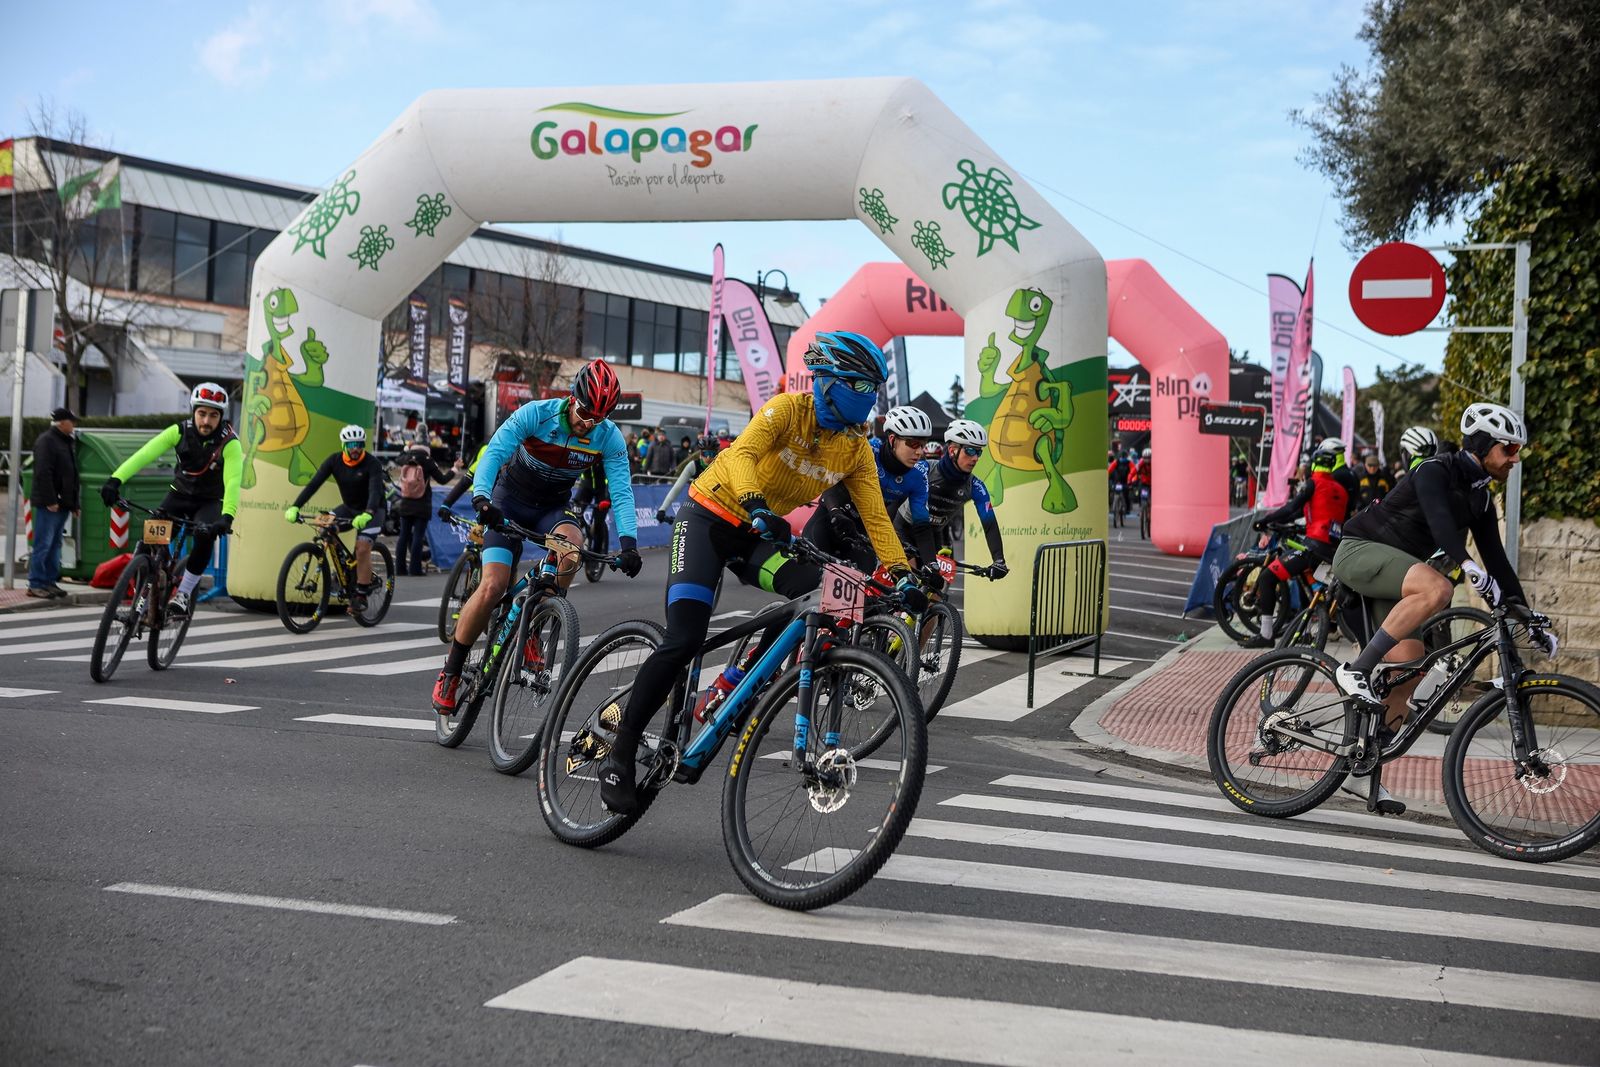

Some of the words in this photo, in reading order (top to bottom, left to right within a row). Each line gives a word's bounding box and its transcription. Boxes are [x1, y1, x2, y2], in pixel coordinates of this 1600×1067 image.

[531, 121, 759, 168] Galapagar
[606, 164, 642, 187] Pasión
[646, 174, 664, 194] por
[668, 163, 679, 188] el
[680, 165, 726, 193] deporte
[906, 278, 953, 312] kl
[1156, 376, 1190, 397] klin
[1213, 416, 1258, 426] SCOTT
[149, 525, 166, 536] 419
[674, 521, 682, 533] DE
[1041, 523, 1051, 536] de
[671, 535, 680, 574] ENMEDIO
[677, 536, 686, 573] MORALEJA
[833, 578, 859, 604] 801
[1517, 679, 1559, 688] AXXIS
[729, 717, 759, 778] MAXXIS
[1223, 781, 1255, 805] MAXXIS
